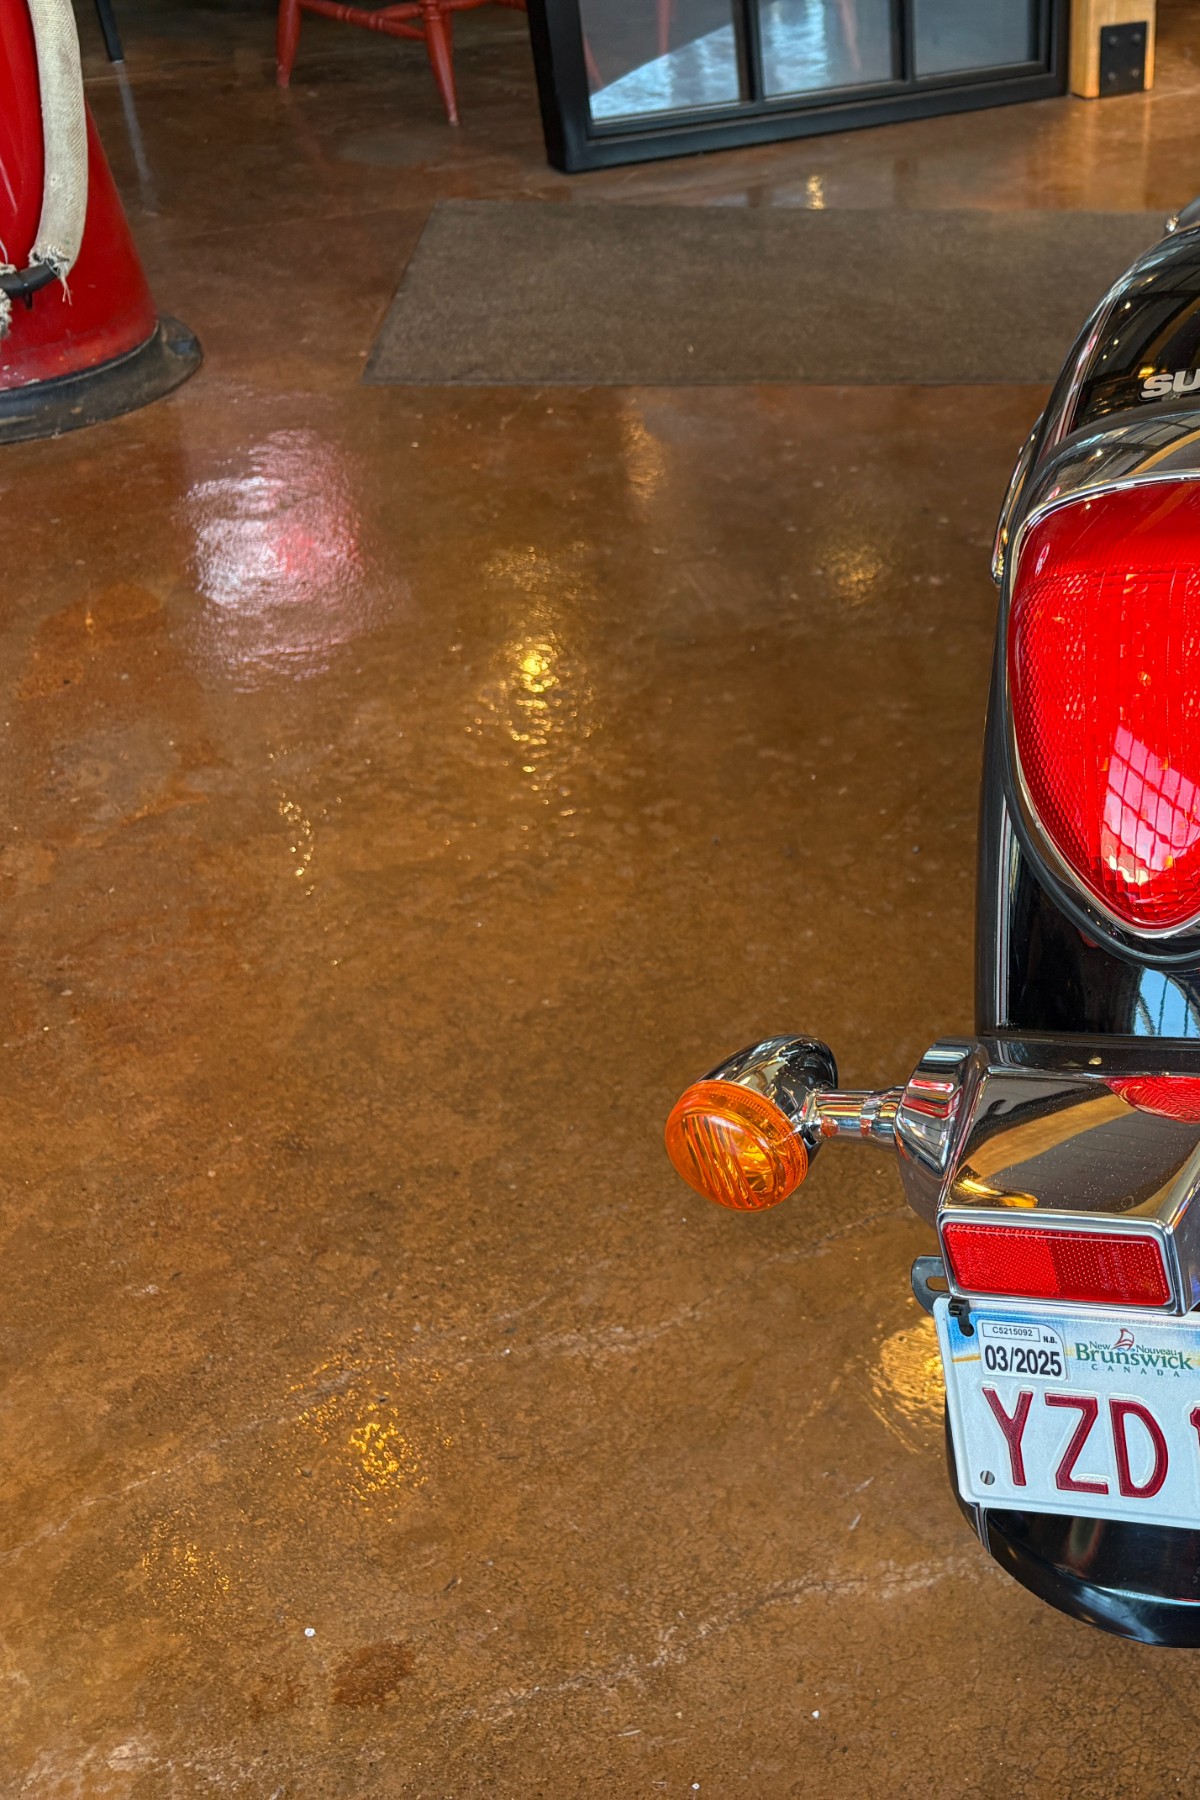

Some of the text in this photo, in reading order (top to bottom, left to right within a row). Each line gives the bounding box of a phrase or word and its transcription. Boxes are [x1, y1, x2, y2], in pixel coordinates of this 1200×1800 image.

[992, 1326, 1033, 1337] C5215092
[1043, 1335, 1058, 1345] N.B.
[1089, 1340, 1178, 1356] New Nouveau
[984, 1344, 1063, 1377] 03/2025
[1075, 1342, 1194, 1371] Brunswick
[1091, 1363, 1180, 1378] CANADA
